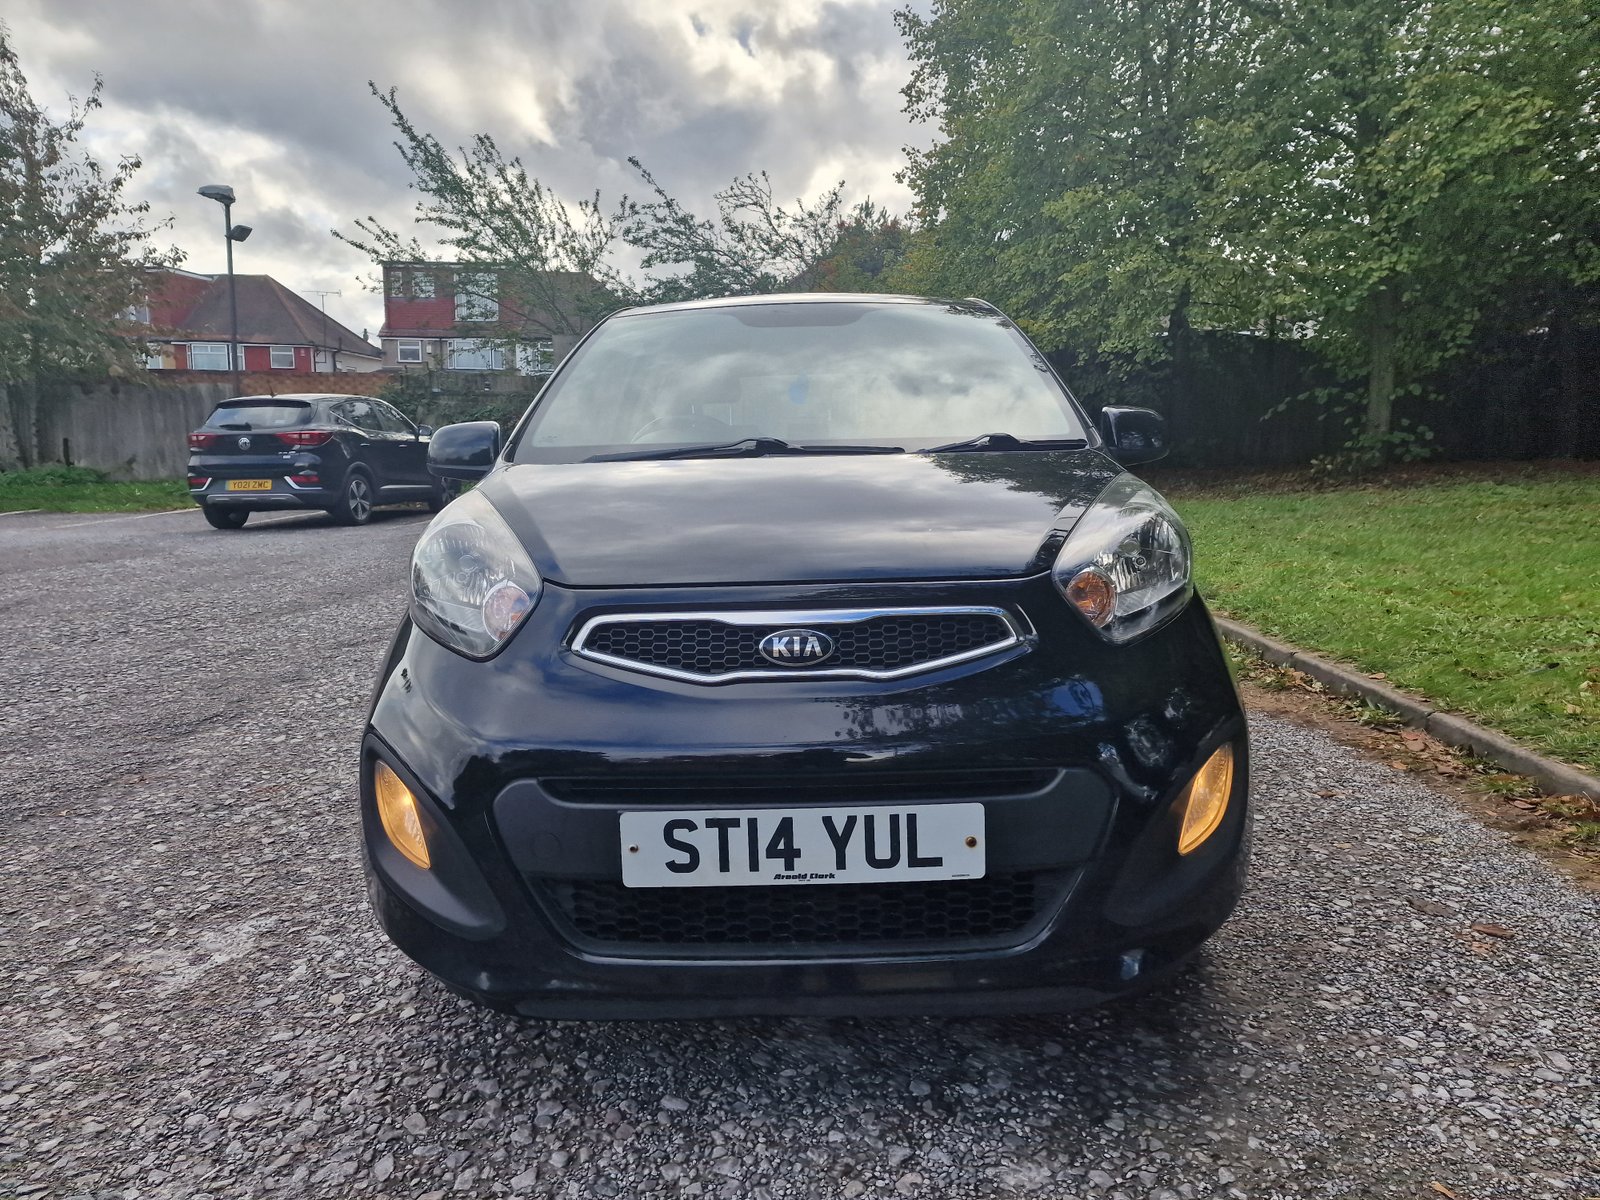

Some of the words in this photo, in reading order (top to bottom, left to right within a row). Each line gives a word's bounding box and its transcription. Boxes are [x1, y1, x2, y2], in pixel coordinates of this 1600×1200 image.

[232, 481, 250, 489] YO21
[772, 636, 823, 657] KIA
[662, 816, 802, 874] ST14
[821, 813, 943, 871] YUL
[809, 872, 836, 880] Clark
